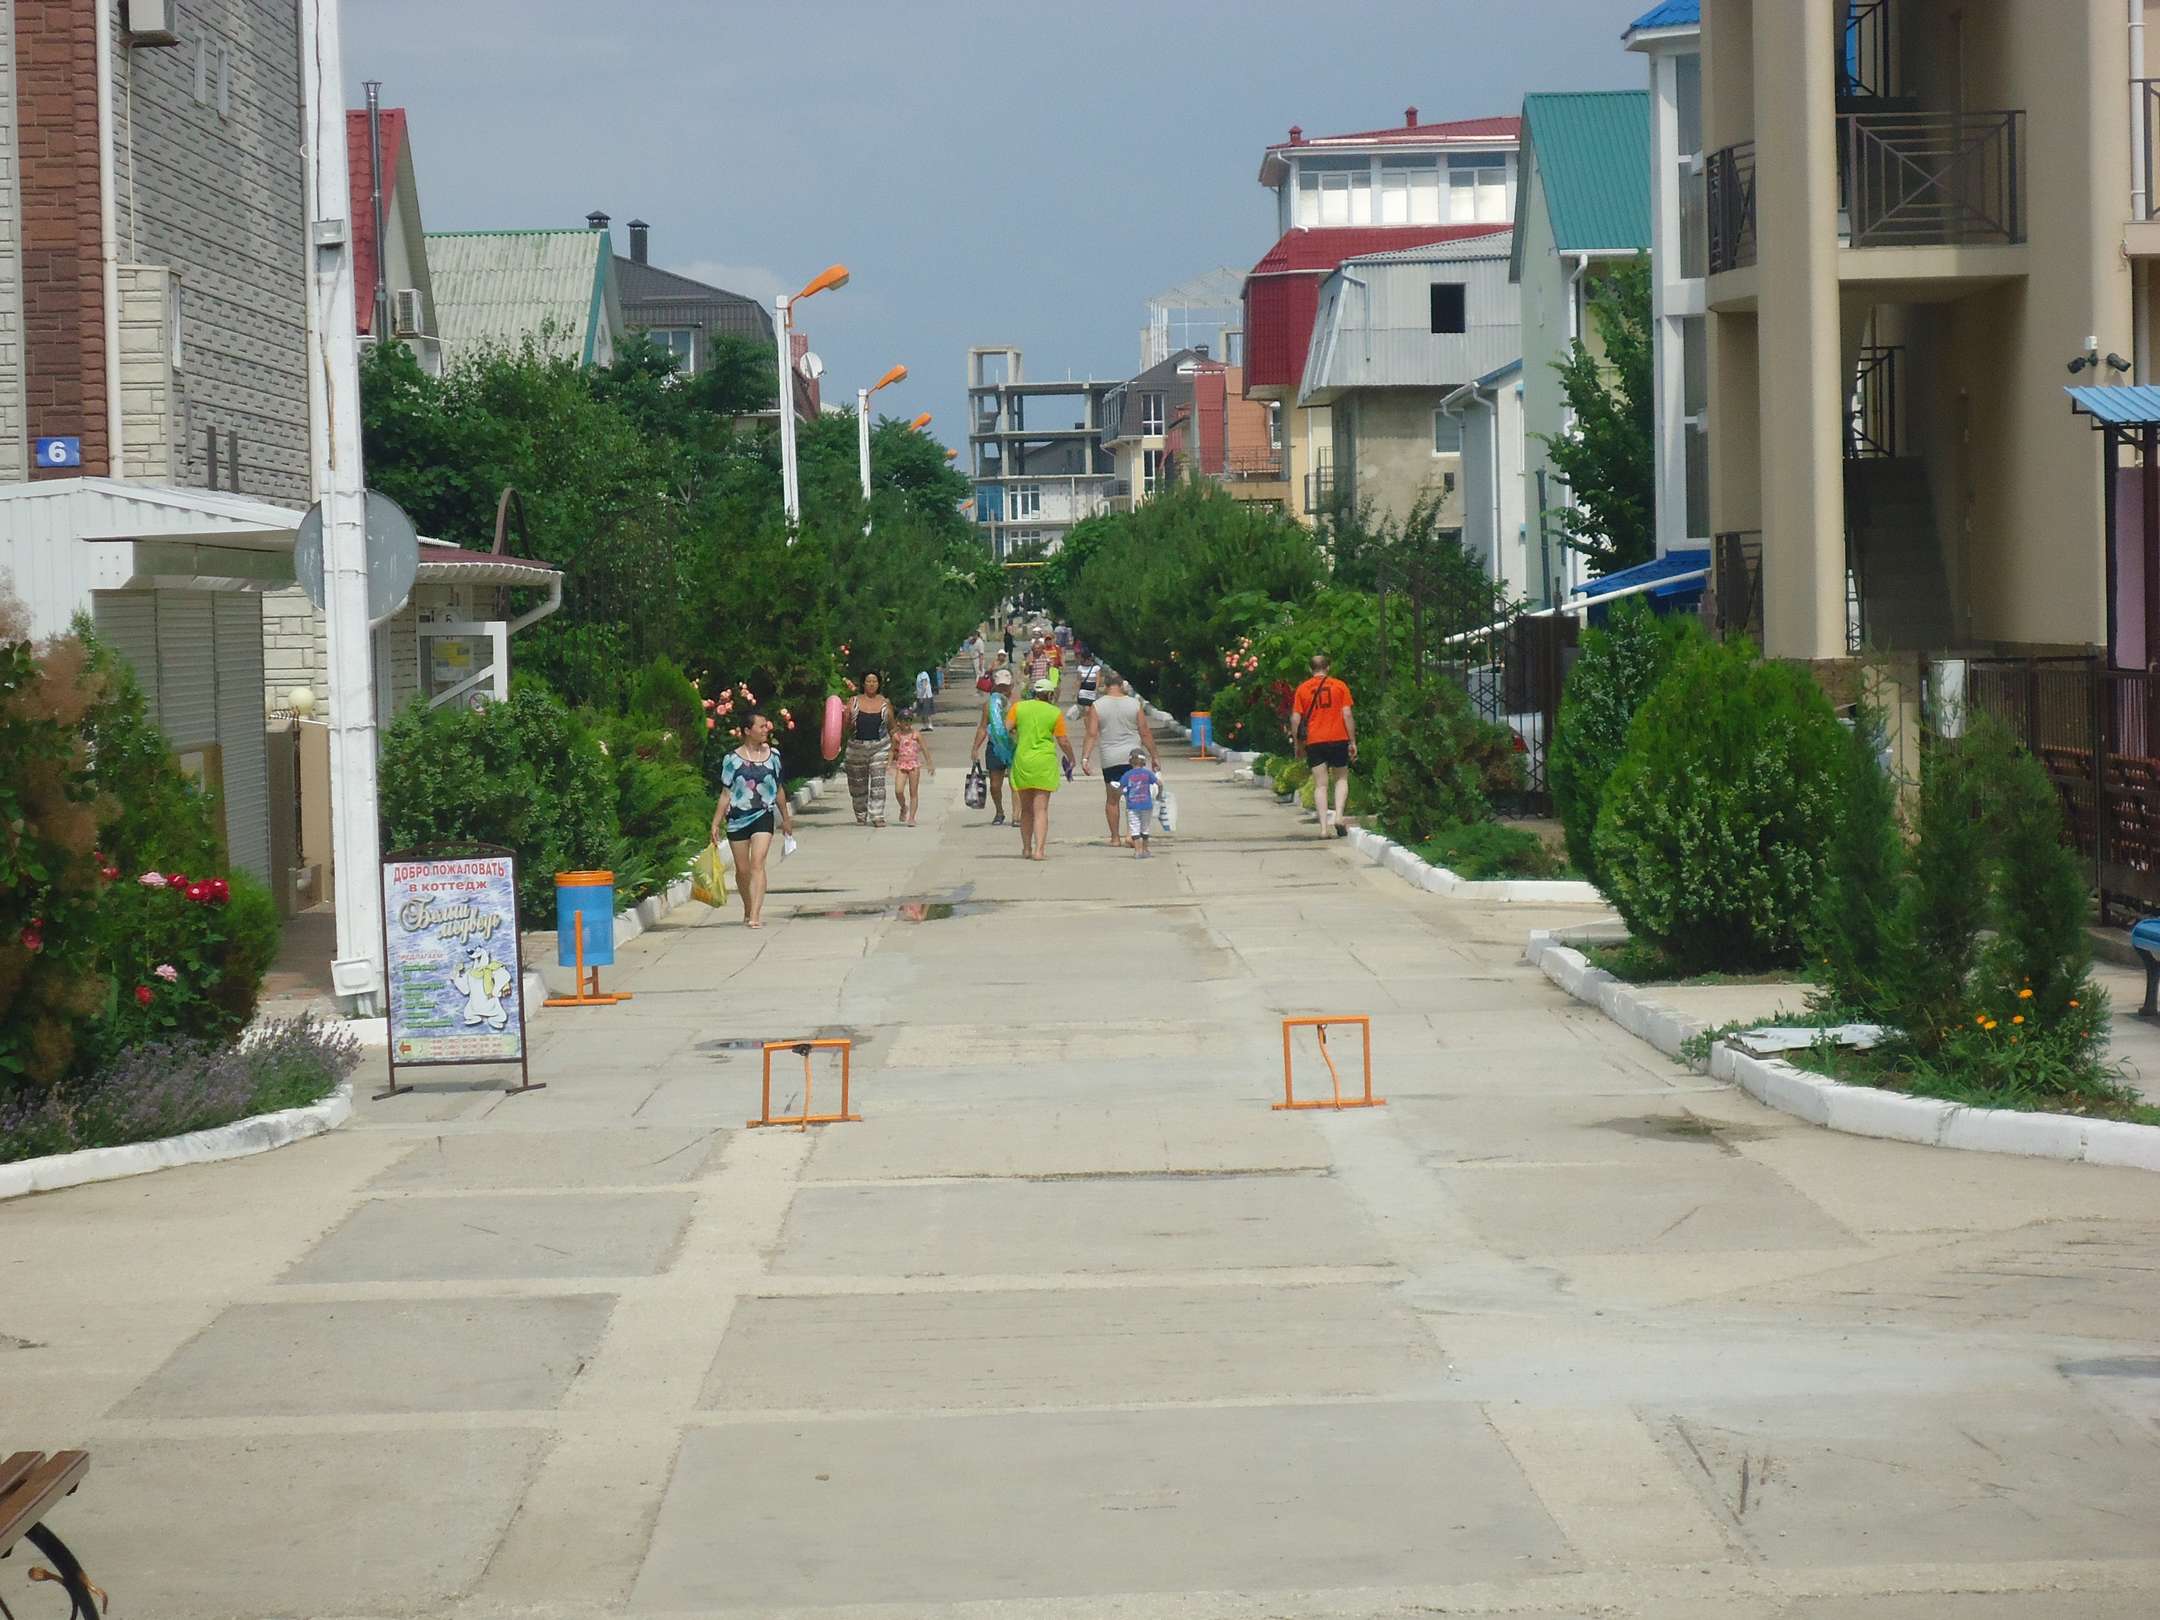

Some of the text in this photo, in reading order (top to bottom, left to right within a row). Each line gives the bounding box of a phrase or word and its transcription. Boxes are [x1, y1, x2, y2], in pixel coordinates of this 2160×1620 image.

[48, 441, 67, 463] 6
[394, 862, 505, 884] ДОБРО ПОЖАЛОВАТЬ
[408, 880, 487, 892] в коттедж
